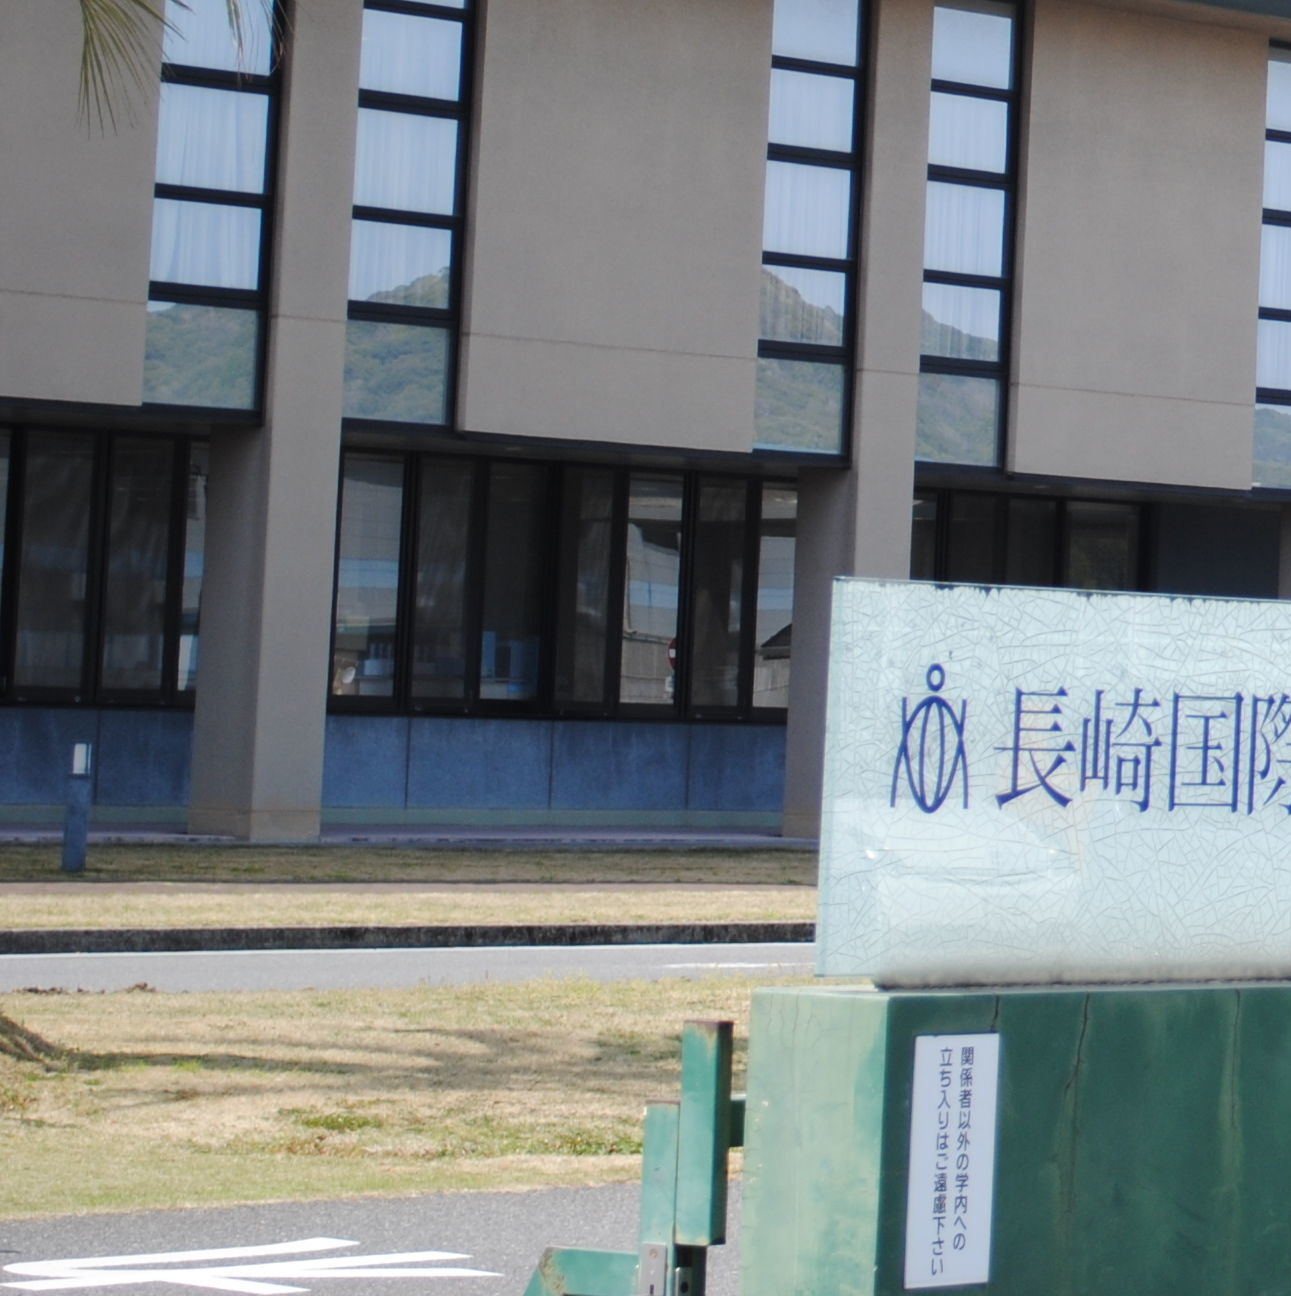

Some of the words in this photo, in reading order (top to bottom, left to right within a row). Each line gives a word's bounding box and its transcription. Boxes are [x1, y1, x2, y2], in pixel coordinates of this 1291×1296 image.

[931, 1047, 952, 1277] 立ち入りはご遠慮下さい
[953, 1046, 974, 1251] 関係者以外の学内への
